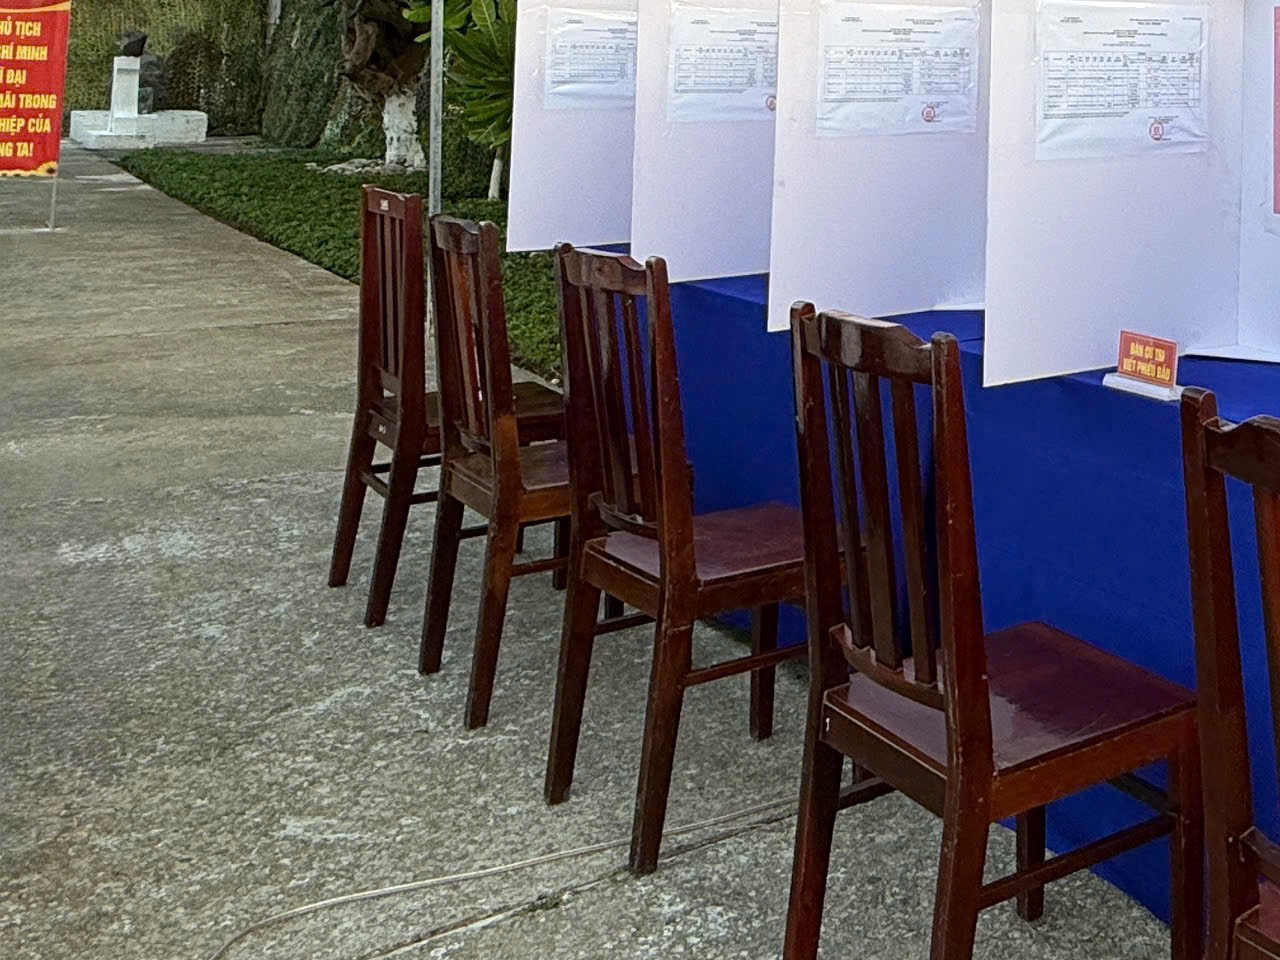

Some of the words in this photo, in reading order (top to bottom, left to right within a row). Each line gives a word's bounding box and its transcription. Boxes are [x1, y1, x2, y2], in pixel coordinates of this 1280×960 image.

[15, 21, 41, 39] TỊCH
[16, 45, 48, 61] MINH
[19, 94, 57, 109] TRONG
[28, 113, 51, 133] CỦA
[16, 142, 34, 157] TA!
